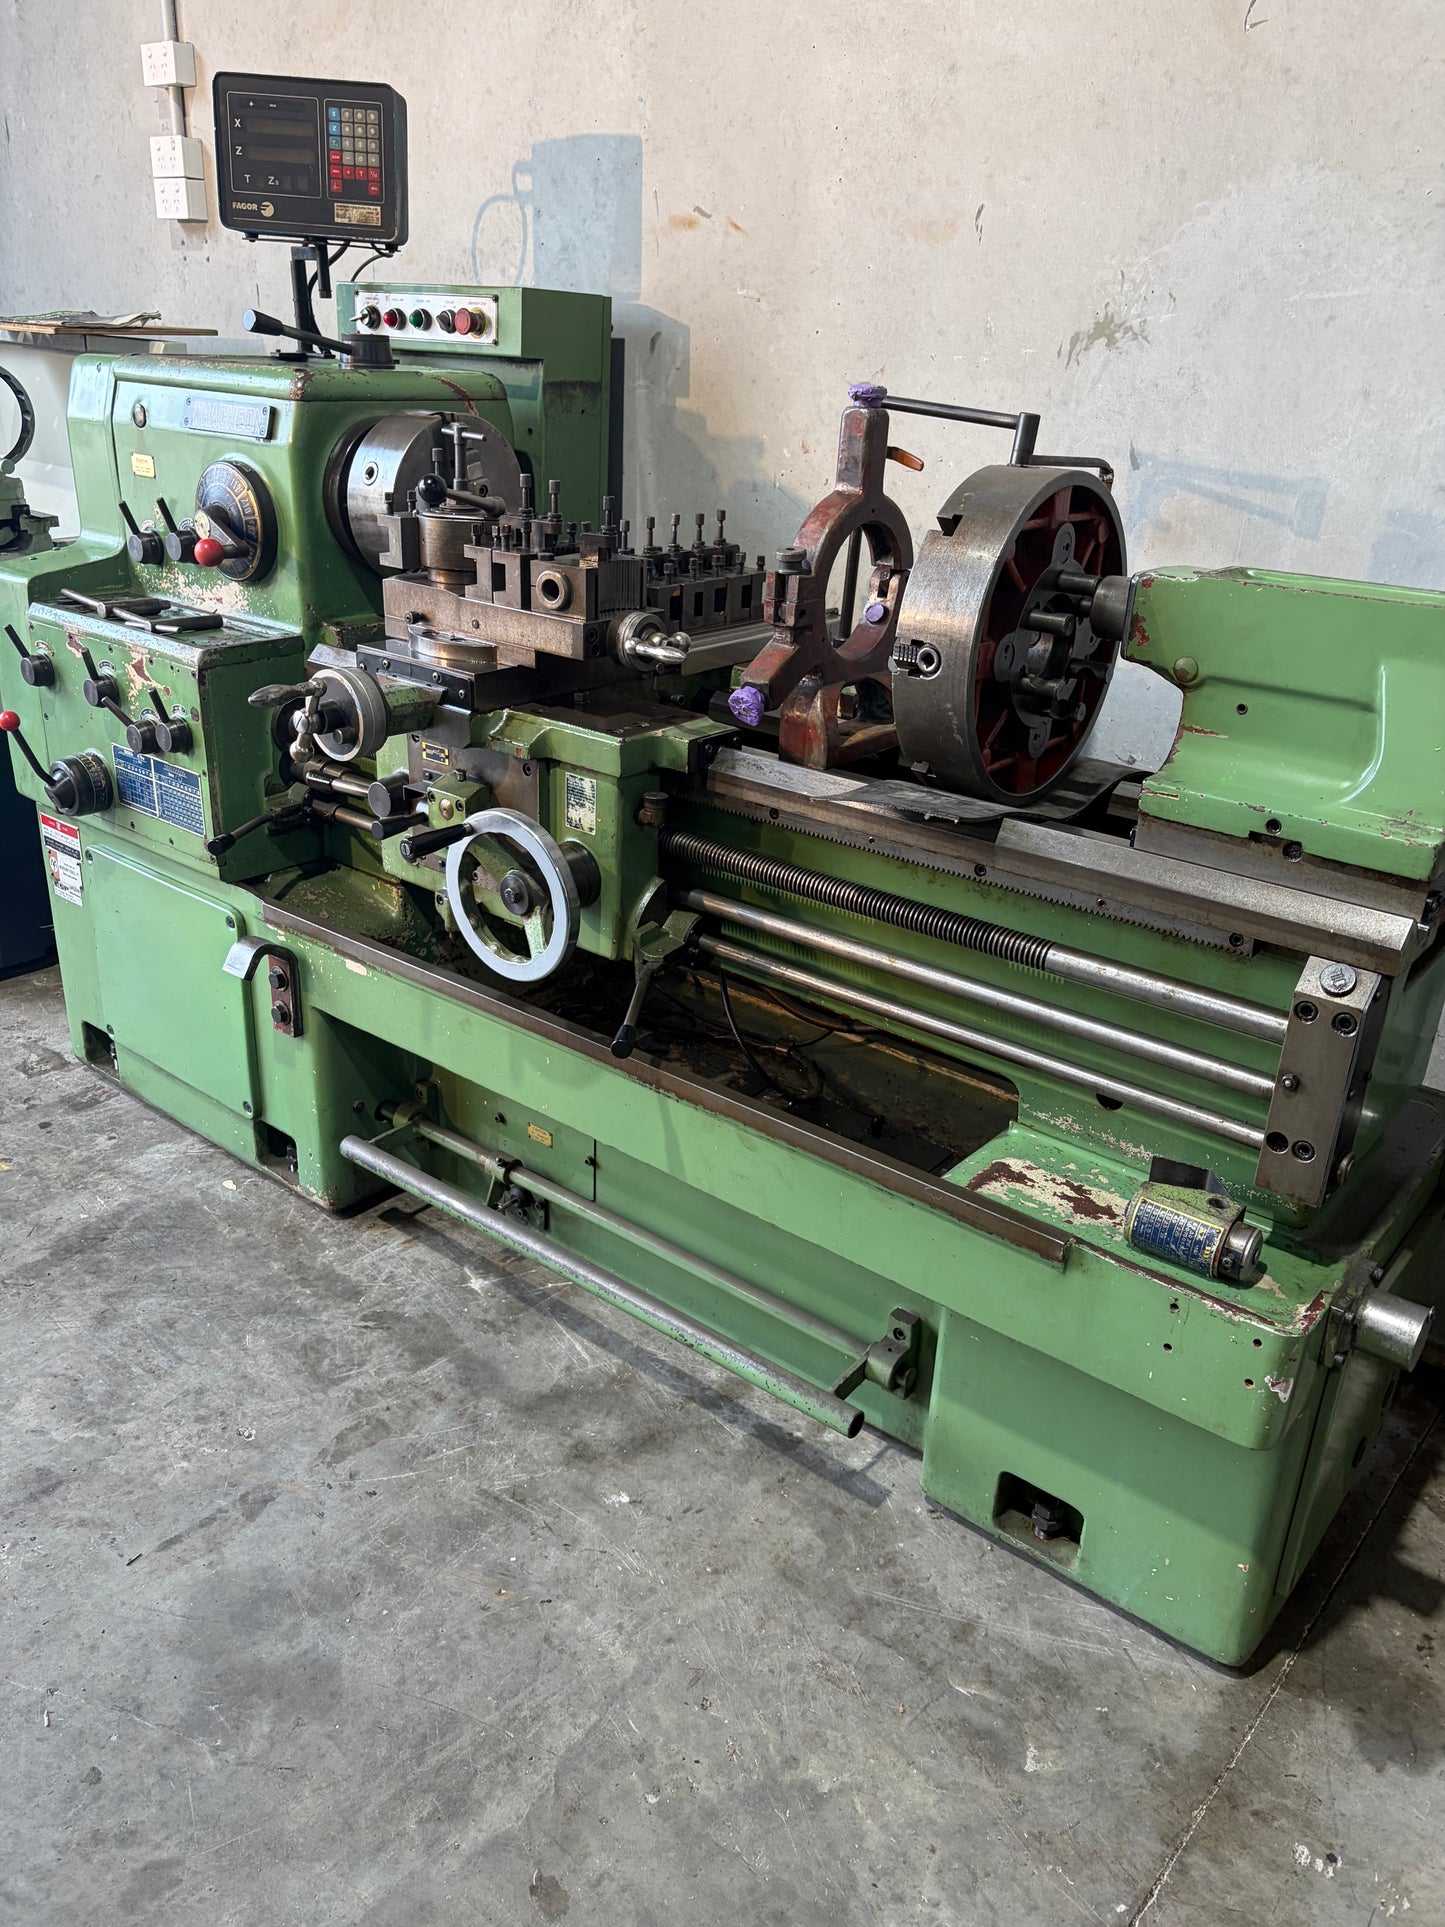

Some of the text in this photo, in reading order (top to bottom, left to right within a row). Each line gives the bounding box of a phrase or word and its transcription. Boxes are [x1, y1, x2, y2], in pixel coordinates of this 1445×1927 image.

[234, 118, 241, 128] X
[235, 147, 243, 155] Z
[244, 174, 251, 183] T
[232, 201, 258, 211] FAGOR
